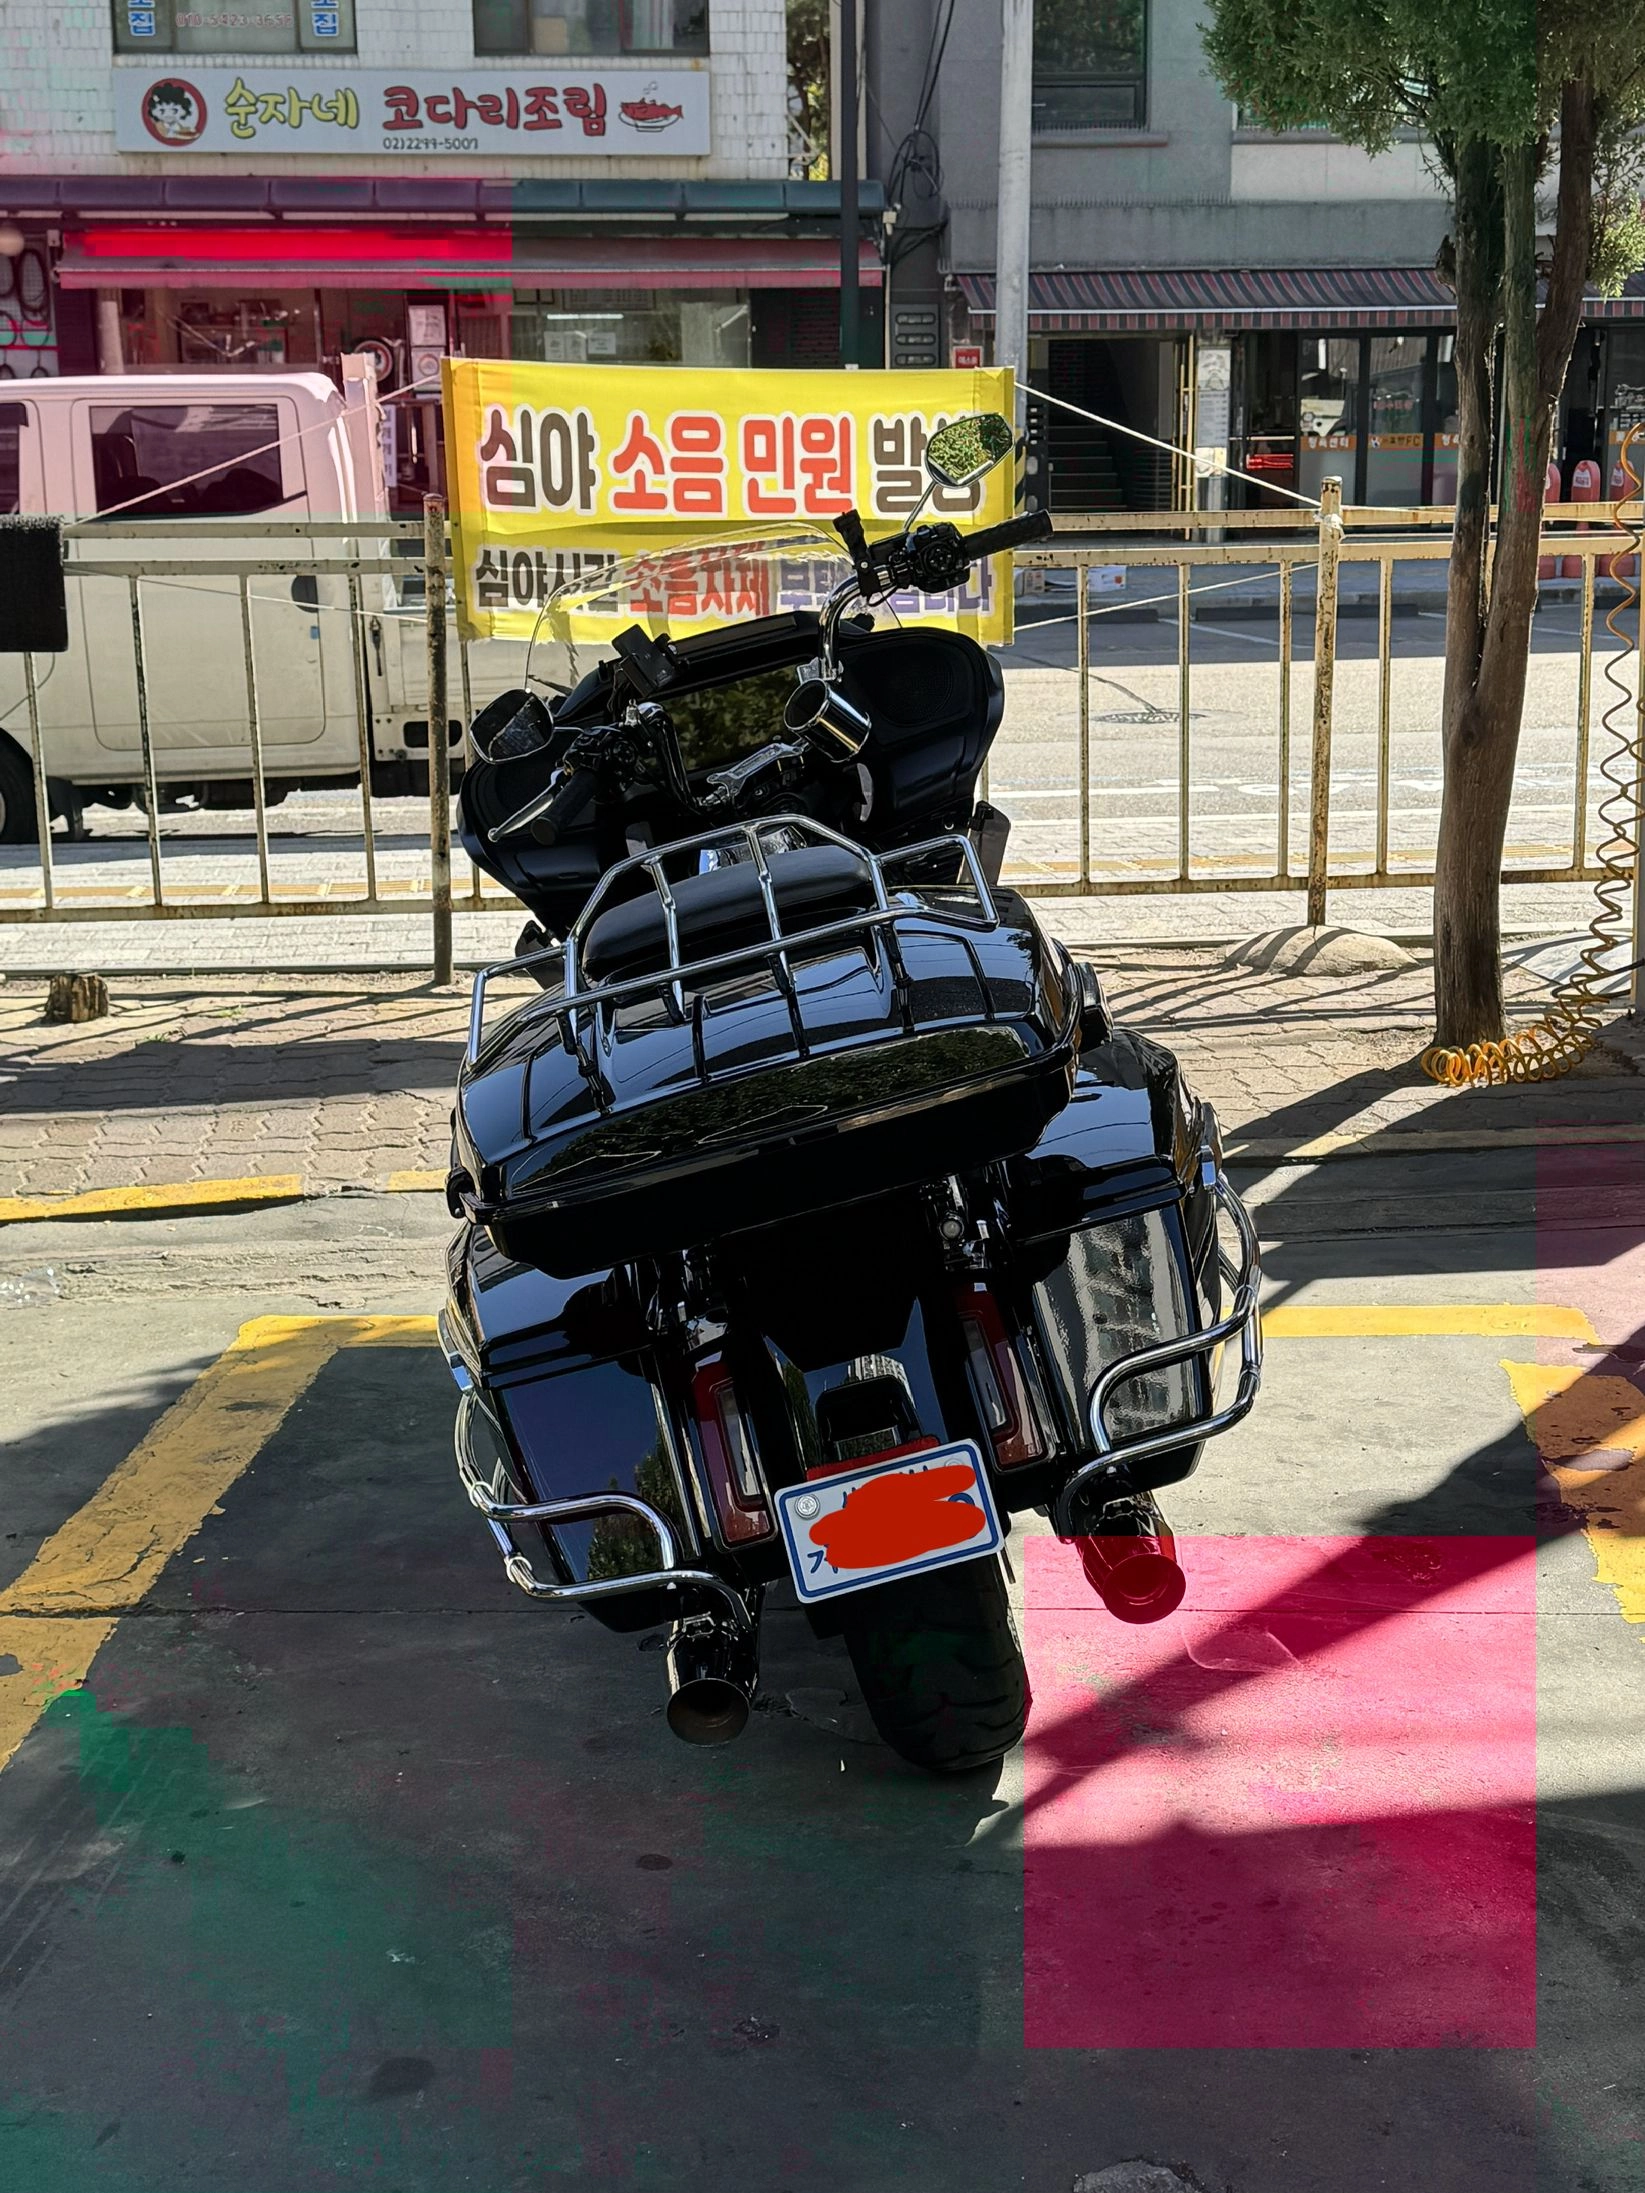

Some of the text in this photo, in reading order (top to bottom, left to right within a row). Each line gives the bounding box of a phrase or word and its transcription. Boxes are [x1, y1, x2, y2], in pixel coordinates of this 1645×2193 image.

[225, 77, 607, 139] 순자네 코다리조림
[480, 408, 597, 510] 심야
[613, 414, 724, 513] 소음
[743, 415, 853, 514] 민원
